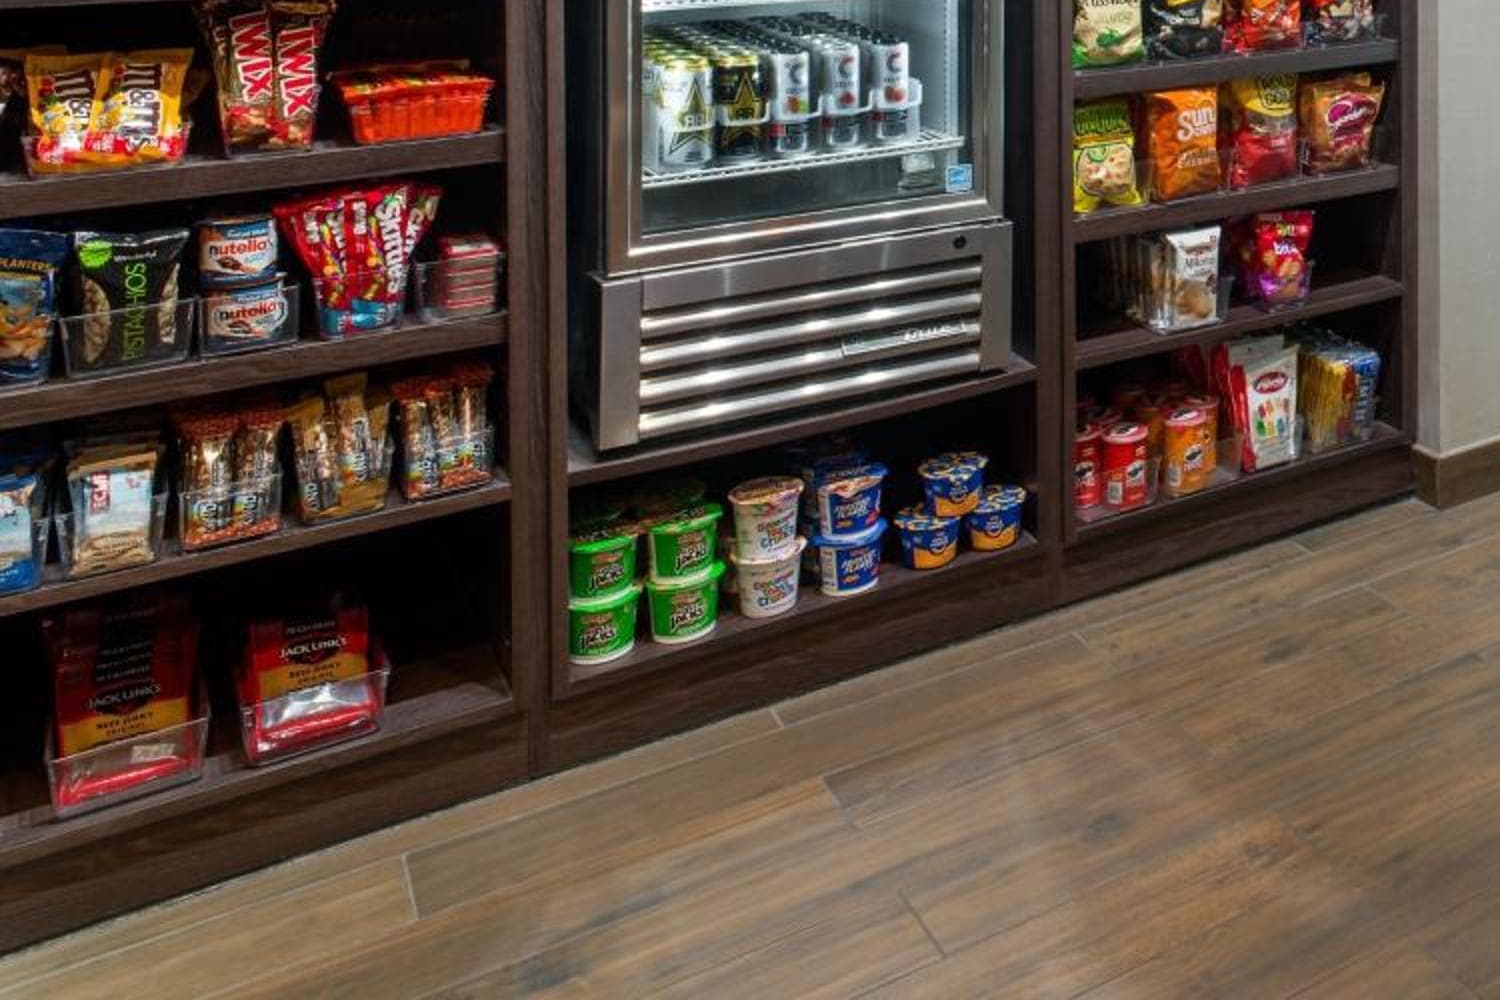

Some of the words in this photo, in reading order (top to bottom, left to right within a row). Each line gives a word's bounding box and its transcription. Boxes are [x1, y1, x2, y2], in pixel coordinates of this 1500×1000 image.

[208, 238, 268, 258] nutella
[219, 301, 277, 322] nutella
[279, 645, 311, 660] JACK
